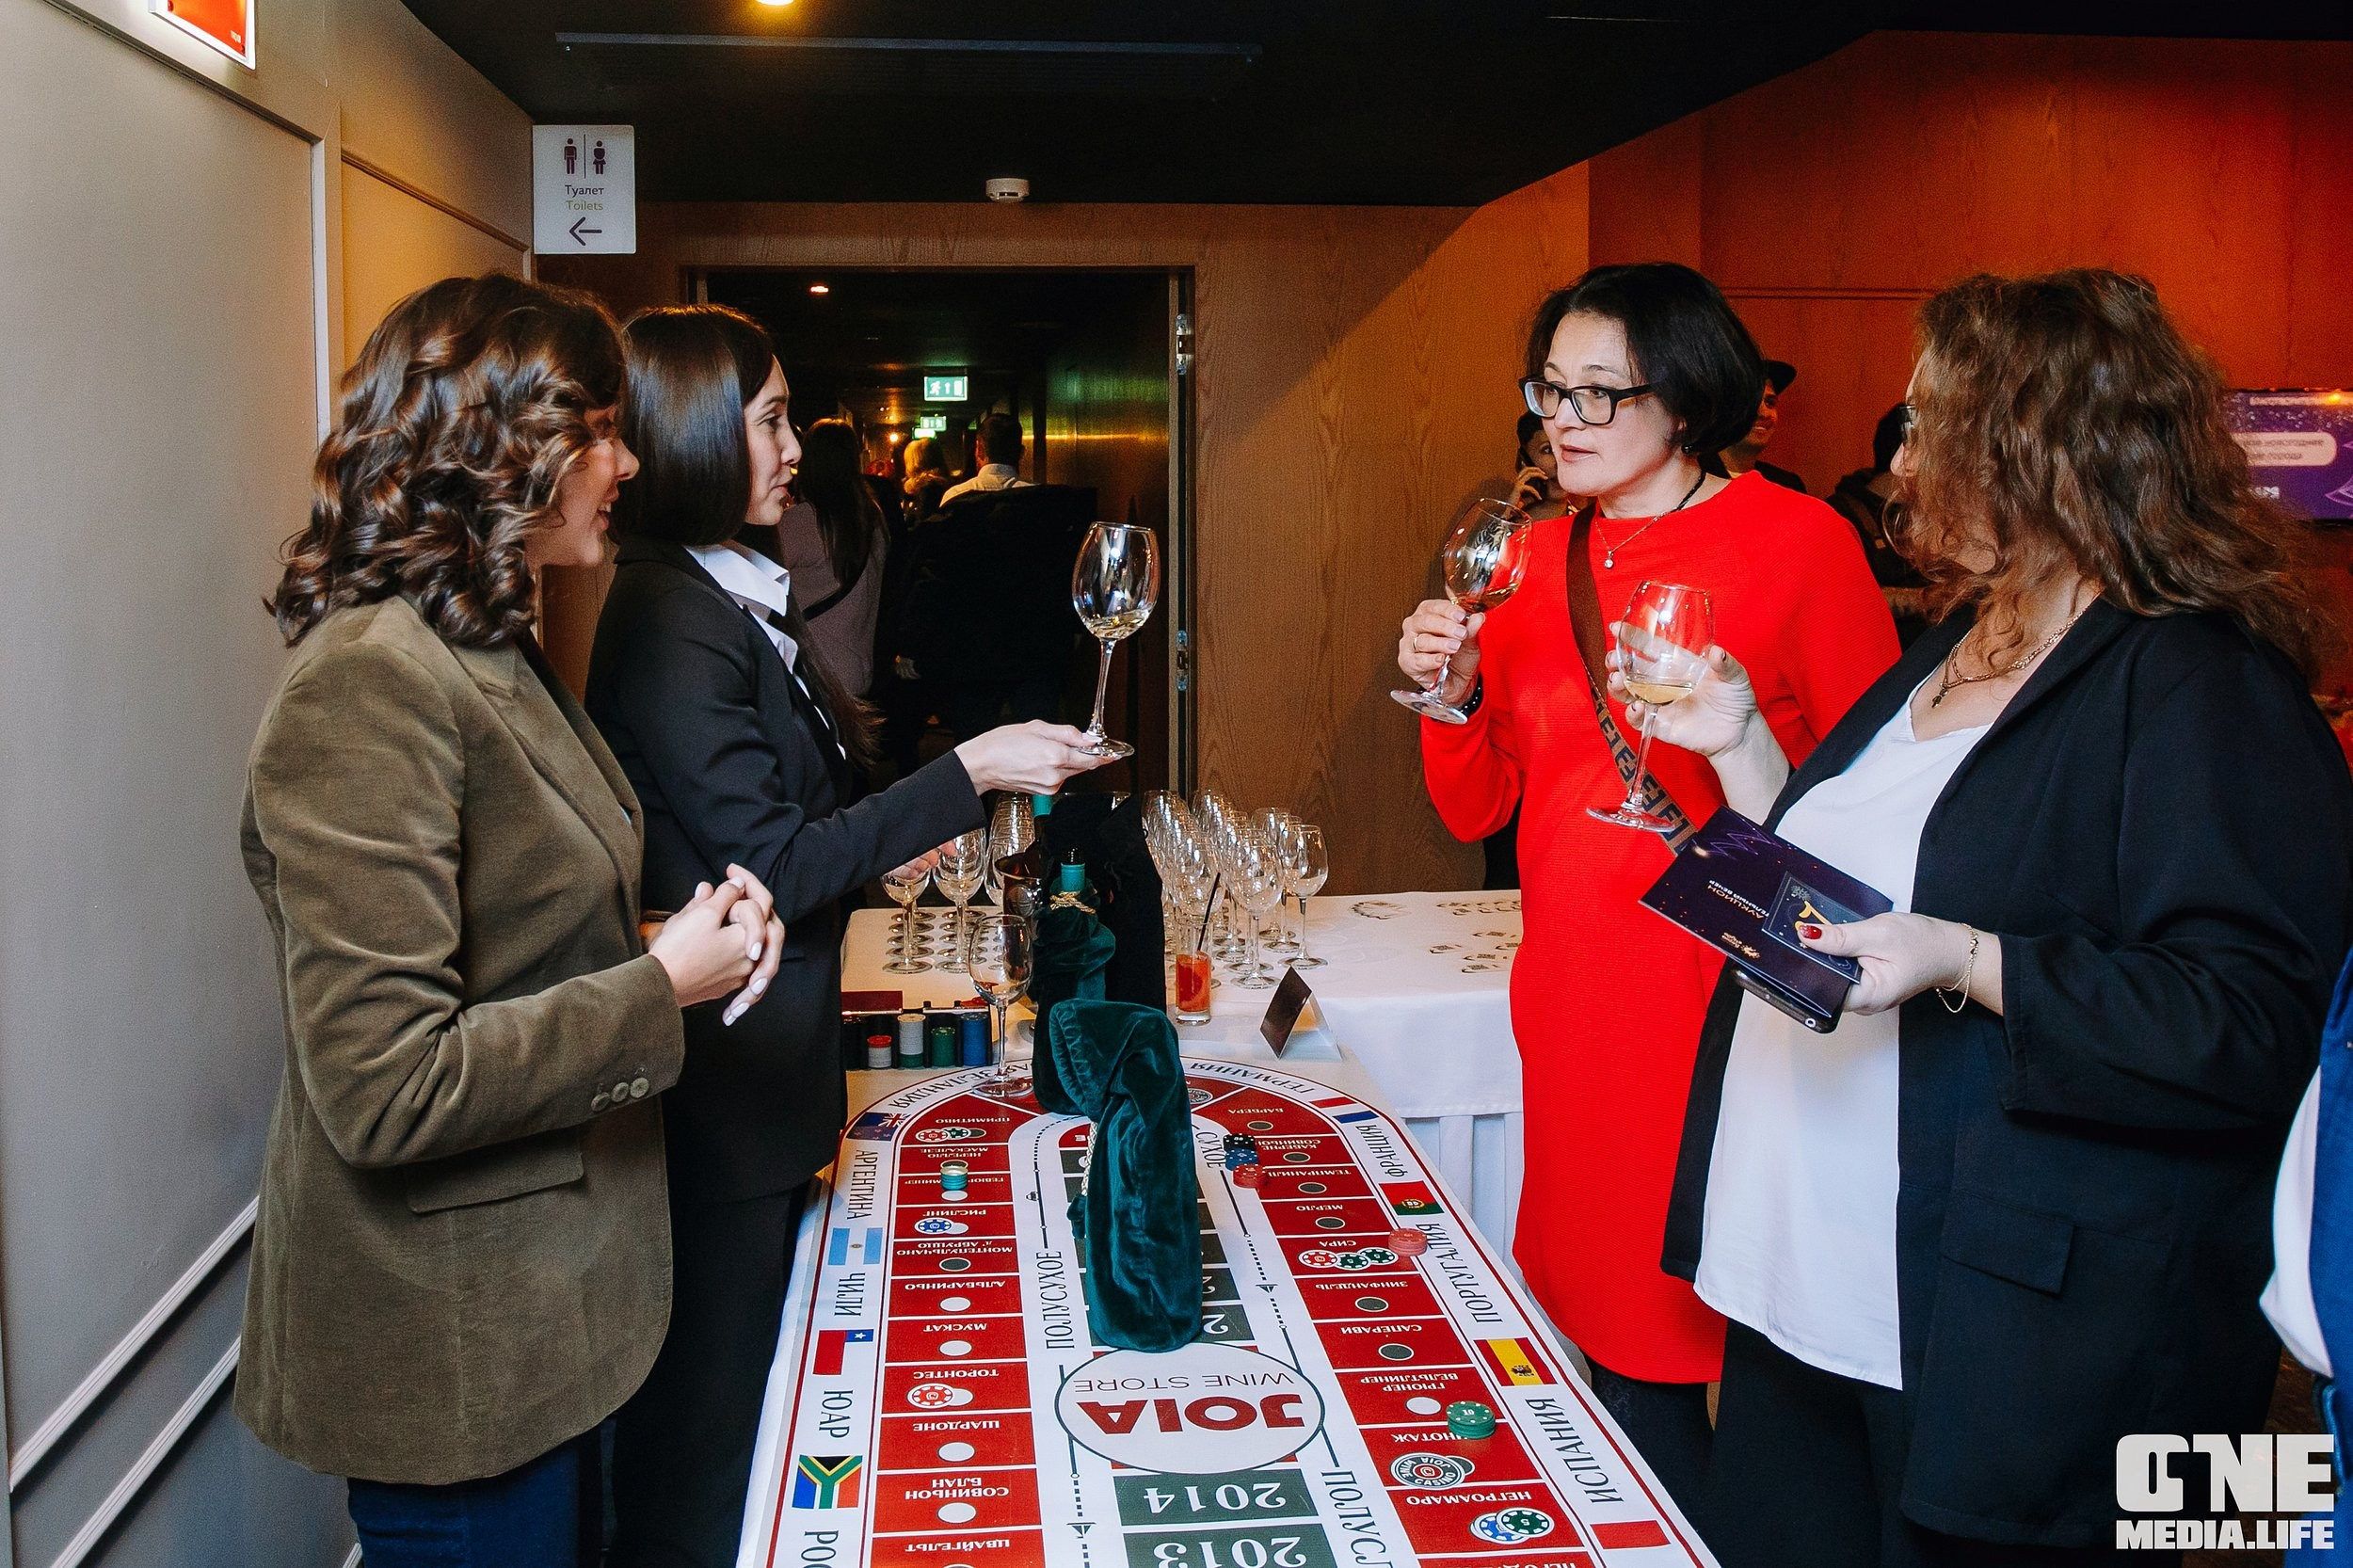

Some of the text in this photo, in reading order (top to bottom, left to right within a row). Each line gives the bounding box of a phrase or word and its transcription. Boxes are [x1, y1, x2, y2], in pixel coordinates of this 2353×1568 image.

[565, 184, 604, 198] Туалет
[566, 200, 603, 211] Toilets
[1708, 886, 1764, 919] АУКЦИОН
[1190, 1063, 1316, 1095] ГЕРМАНИЯ
[888, 1069, 992, 1110] ЗЕЛАНДИЯ
[1227, 1107, 1284, 1115] БАРБЕРА
[1195, 1132, 1226, 1169] СУХОЕ
[1354, 1124, 1406, 1178] ФРАНЦИЯ
[847, 1149, 878, 1220] АРГЕНТИНА
[922, 1208, 987, 1217] РИСЛИНГ
[896, 1246, 1013, 1256] МОНТЕПУЛЬЧАНО
[1416, 1223, 1504, 1323] ПОРТУГАЛИЯ
[904, 1280, 1006, 1290] АЛЬБАРИНЬО
[1315, 1280, 1409, 1290] ЗИНФАНДЕЛЬ
[834, 1272, 866, 1317] ЧИЛИ
[1036, 1250, 1075, 1349] ПОЛУСУХОЕ
[923, 1322, 987, 1332] МУСКАТ
[1340, 1323, 1423, 1335] САПЕРАВИ
[913, 1368, 1000, 1379] ТОРОНТЕС
[1360, 1373, 1459, 1384] ВЕЛЬТЛИНЕР
[1073, 1371, 1295, 1393] WINE STORE
[1383, 1382, 1447, 1392] ГРЮНЕР
[818, 1389, 854, 1439] ЮАР
[1077, 1393, 1305, 1434] JOIA
[912, 1419, 1000, 1432] ШАРДОНЕ
[1525, 1397, 1624, 1504] ИСПАНИЯ
[1420, 1456, 1451, 1469] JOIA
[932, 1477, 983, 1488] БЛАН
[1414, 1472, 1457, 1486] CASINO
[904, 1487, 1010, 1500] СОВИНЬОН
[1144, 1481, 1288, 1514] 2014
[1406, 1491, 1532, 1505] НЕГРОАМАРО
[904, 1538, 1011, 1552] ЦВАЙГЕЛЬТ
[1153, 1536, 1307, 1568] 2013
